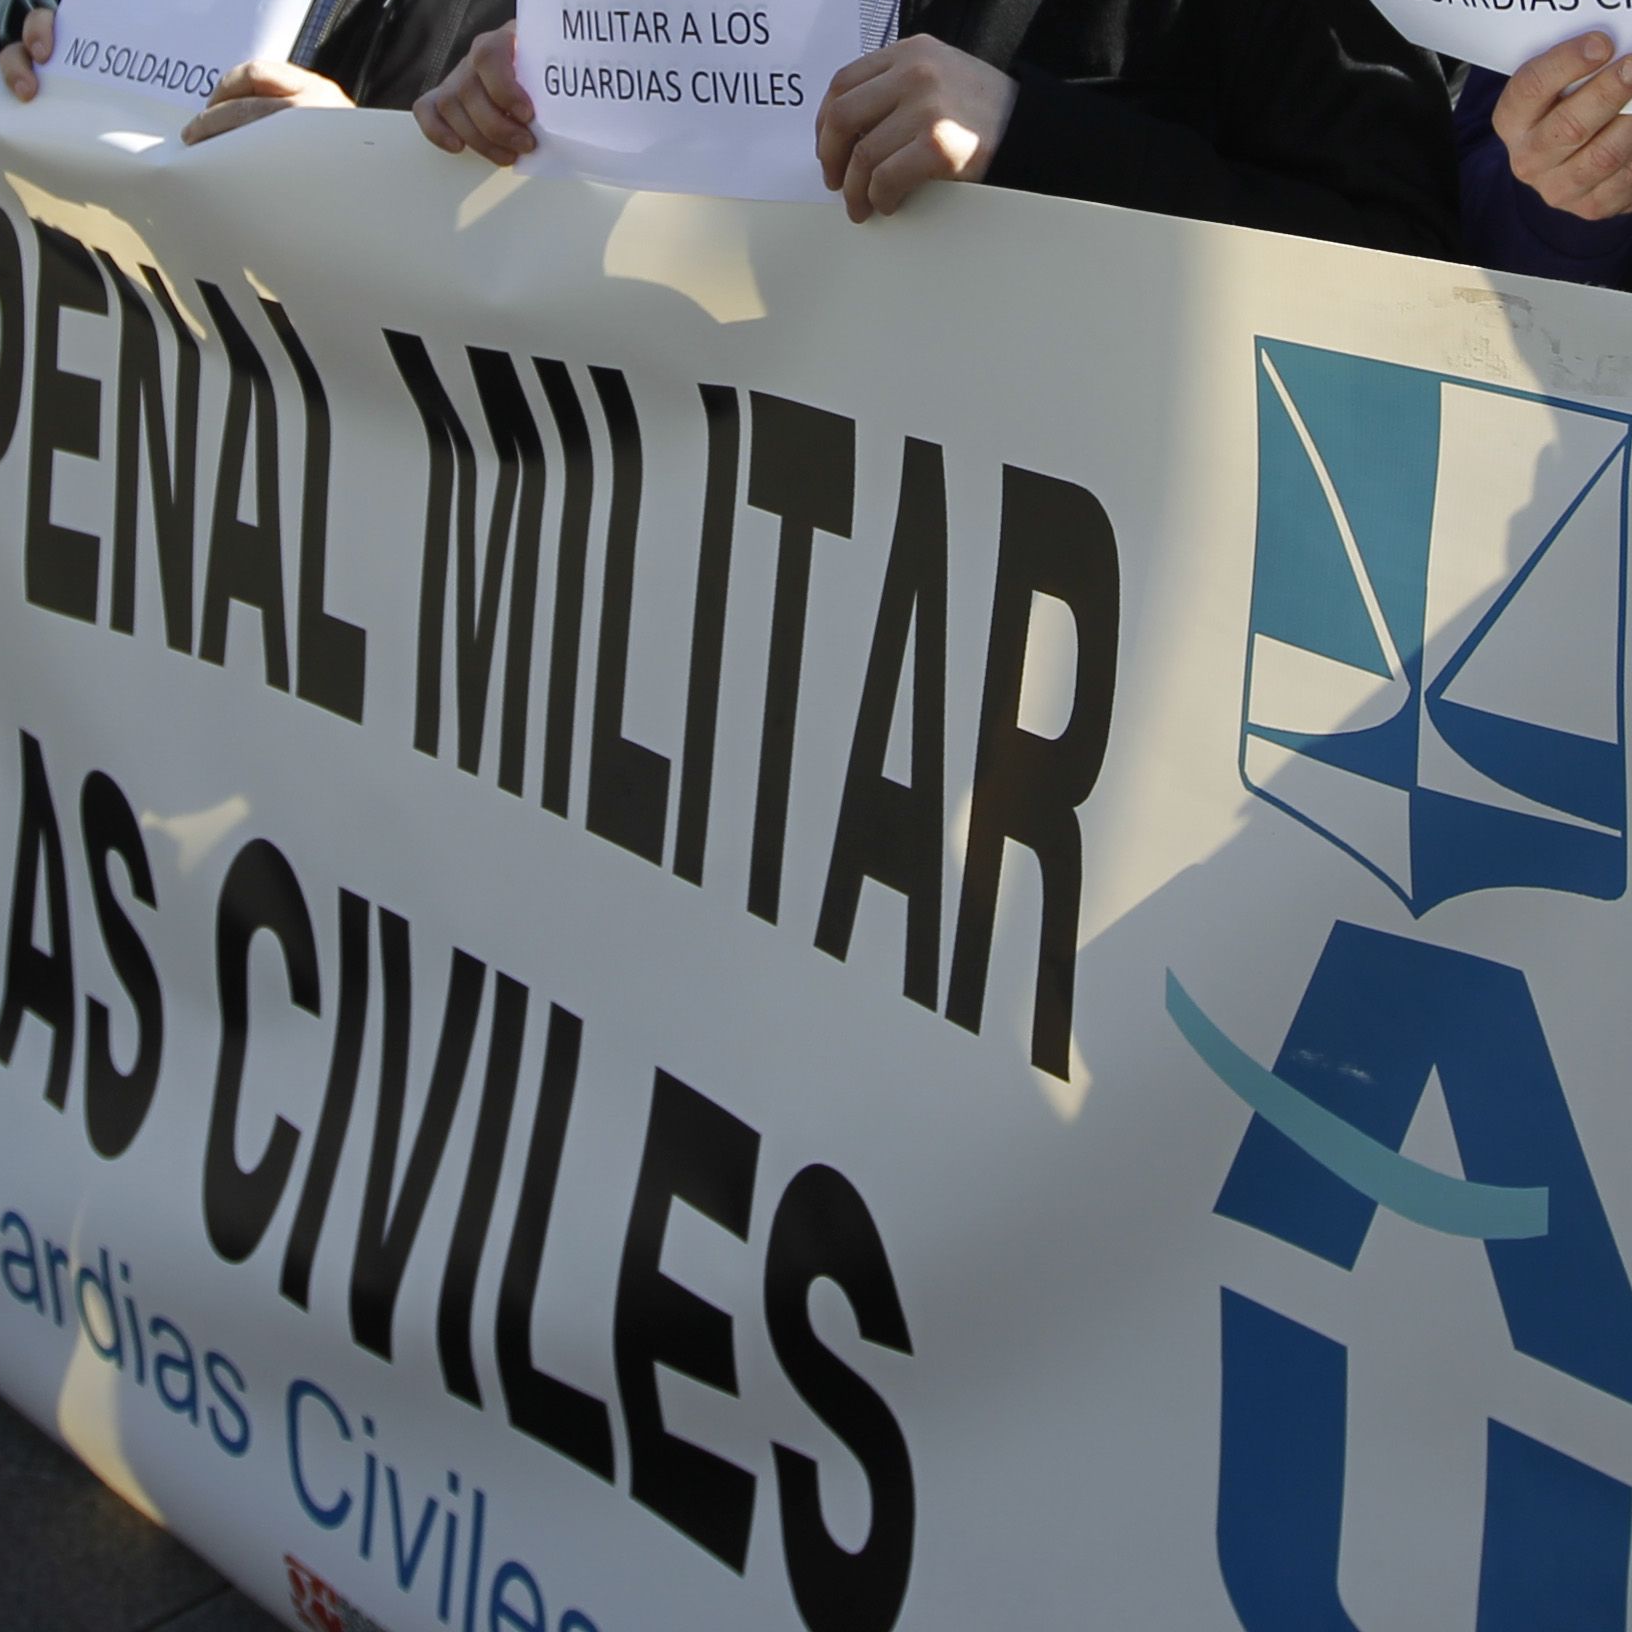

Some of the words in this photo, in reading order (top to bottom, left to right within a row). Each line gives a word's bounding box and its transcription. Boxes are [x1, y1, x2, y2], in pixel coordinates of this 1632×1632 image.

[64, 37, 95, 69] NO
[98, 41, 220, 99] SOLDADOS
[544, 65, 682, 102] GUARDIAS
[691, 70, 804, 106] CIVILES
[561, 9, 670, 44] MILITAR
[680, 12, 702, 44] A
[711, 11, 770, 45] LOS
[382, 328, 1121, 1084] MILITAR
[201, 837, 916, 1632] CIVILES
[286, 1377, 601, 1632] Civile
